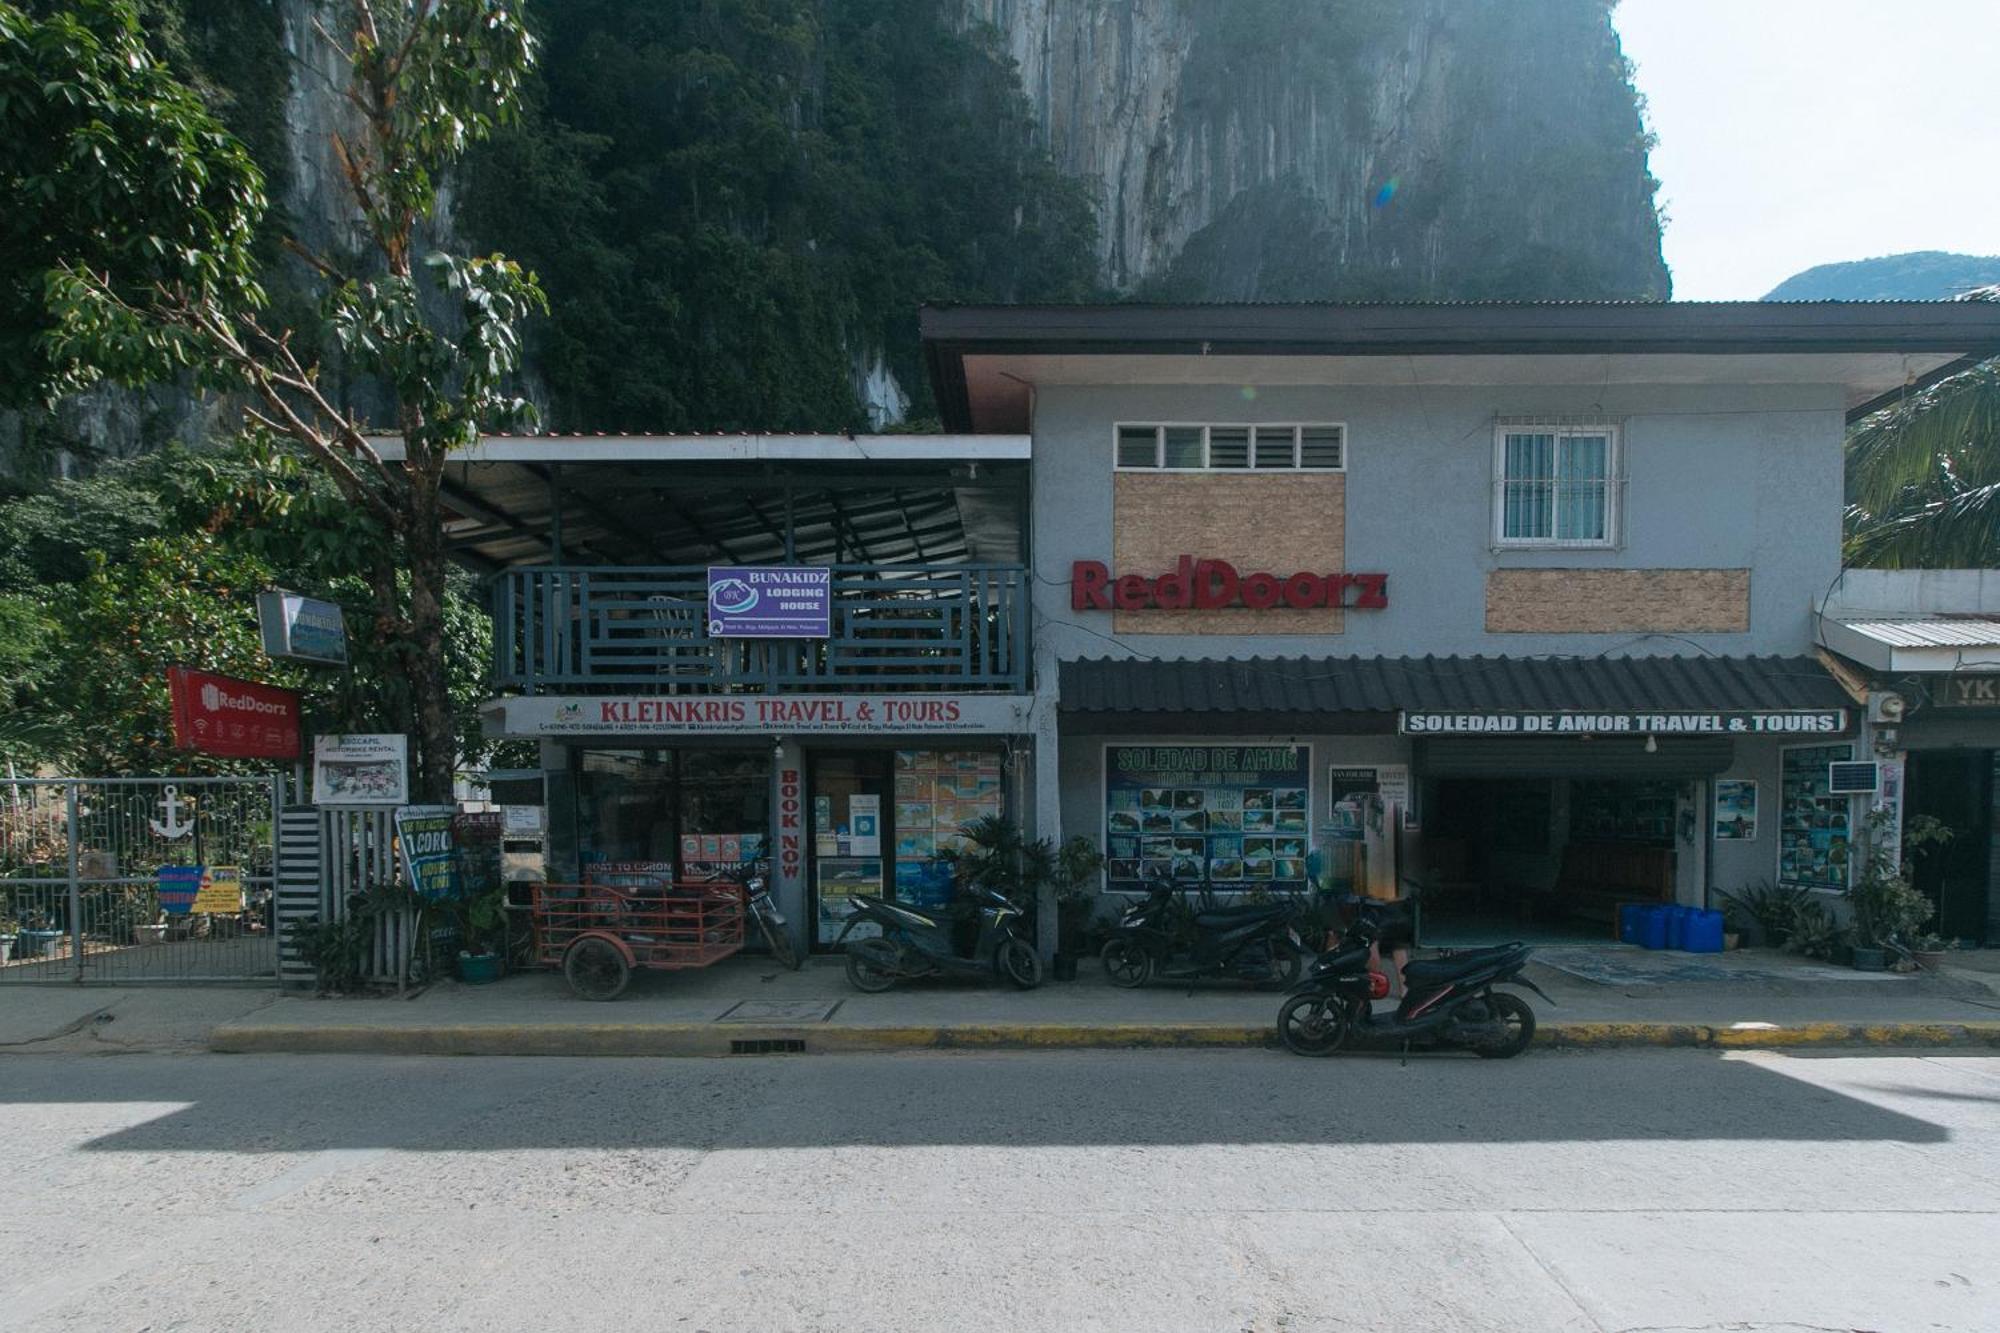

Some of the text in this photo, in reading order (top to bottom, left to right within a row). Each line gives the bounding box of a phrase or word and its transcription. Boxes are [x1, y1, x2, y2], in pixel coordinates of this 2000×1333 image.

[749, 572, 829, 584] BUNAKIDZ
[1072, 554, 1389, 611] RedDoorz
[766, 588, 824, 597] LODGING
[780, 602, 820, 610] HOUSE
[219, 692, 288, 716] RedDoorz
[601, 700, 960, 722] KLEINKRIS TRAVEL & TOURS
[1410, 715, 1834, 731] SOLEDAD DE AMOR TRAVEL & TOURS
[1118, 748, 1298, 771] SOLEDAD DE AMOR
[781, 769, 798, 828] BOOK
[782, 835, 798, 879] NOW
